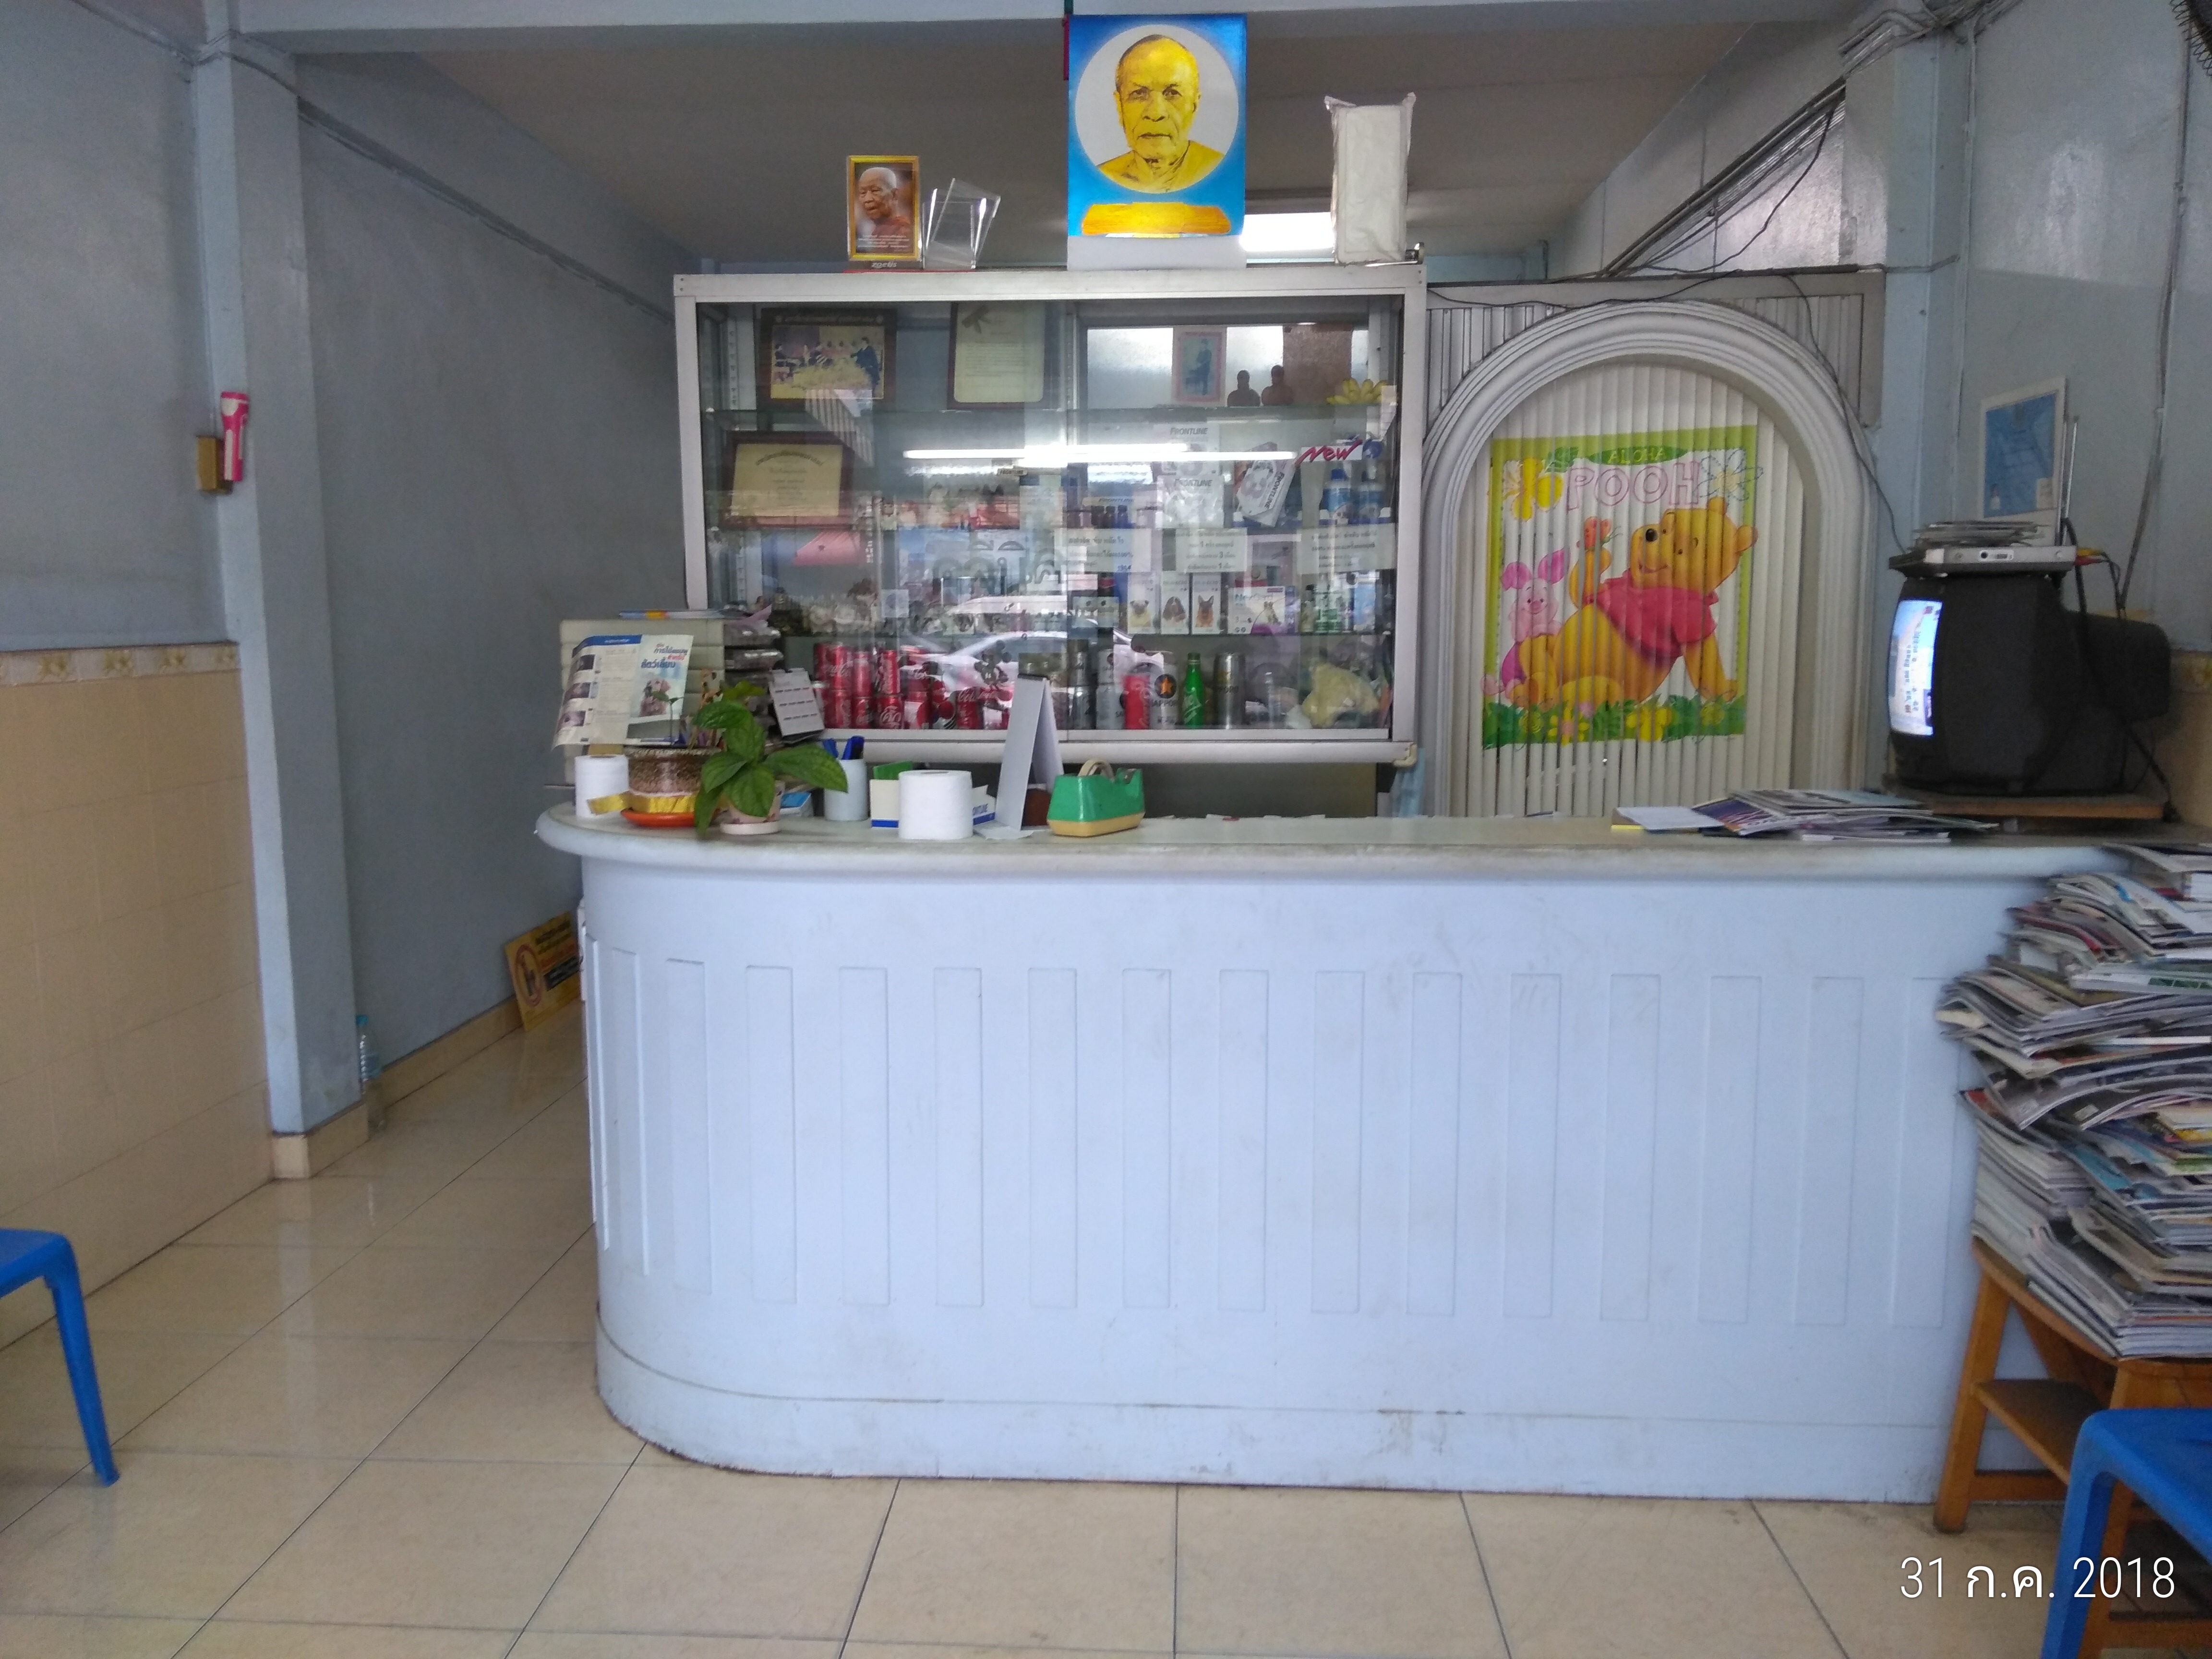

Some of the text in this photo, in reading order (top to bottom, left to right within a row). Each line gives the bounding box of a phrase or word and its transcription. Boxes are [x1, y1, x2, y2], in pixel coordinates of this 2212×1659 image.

[1608, 447, 1665, 465] ALOHA
[1263, 471, 1286, 509] FRONTLINE
[1566, 459, 1700, 511] POOH
